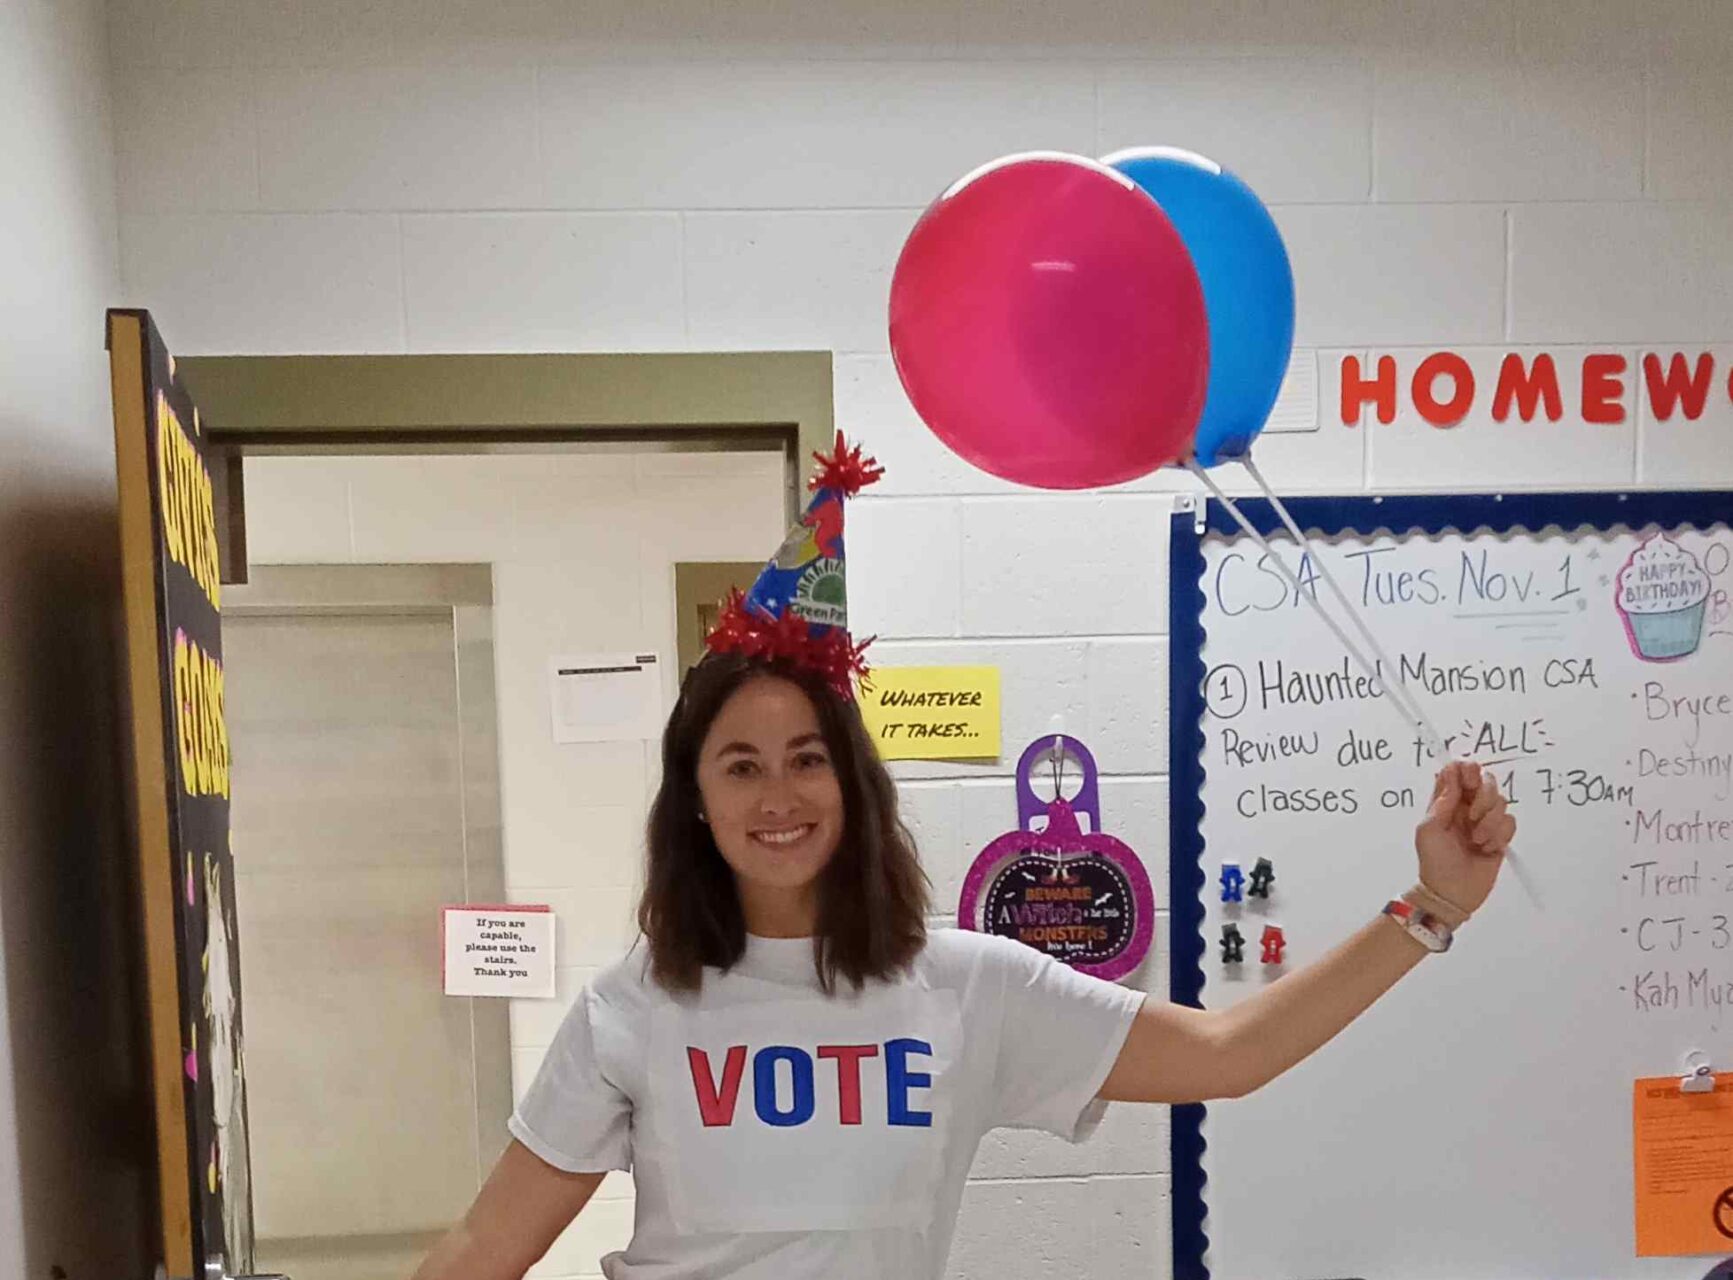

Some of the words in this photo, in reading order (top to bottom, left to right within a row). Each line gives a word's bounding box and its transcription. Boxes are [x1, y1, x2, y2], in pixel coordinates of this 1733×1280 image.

[1341, 351, 1733, 428] HOMEW
[1216, 551, 1321, 616] CSA
[1344, 547, 1447, 607] Tues.
[1457, 549, 1541, 605] Nov.
[1639, 563, 1687, 582] HAPPY
[1258, 655, 1385, 710] Haunted
[1400, 652, 1526, 696] Mansion
[1544, 658, 1599, 689] CSA
[880, 689, 982, 708] WHATEVER
[881, 723, 903, 738] IT
[907, 722, 979, 738] TAKES...
[1221, 728, 1319, 768] Review
[1337, 729, 1393, 768] due
[1473, 720, 1539, 754] ALL
[1237, 784, 1359, 818] classes
[1381, 788, 1414, 808] on
[476, 918, 486, 927] If
[488, 920, 506, 929] you
[480, 931, 522, 941] capable,
[465, 943, 498, 952] please
[519, 945, 536, 953] the
[484, 956, 517, 964] stairs.
[473, 967, 507, 977] Thank
[508, 970, 529, 979] you
[686, 1037, 933, 1128] VOTE
